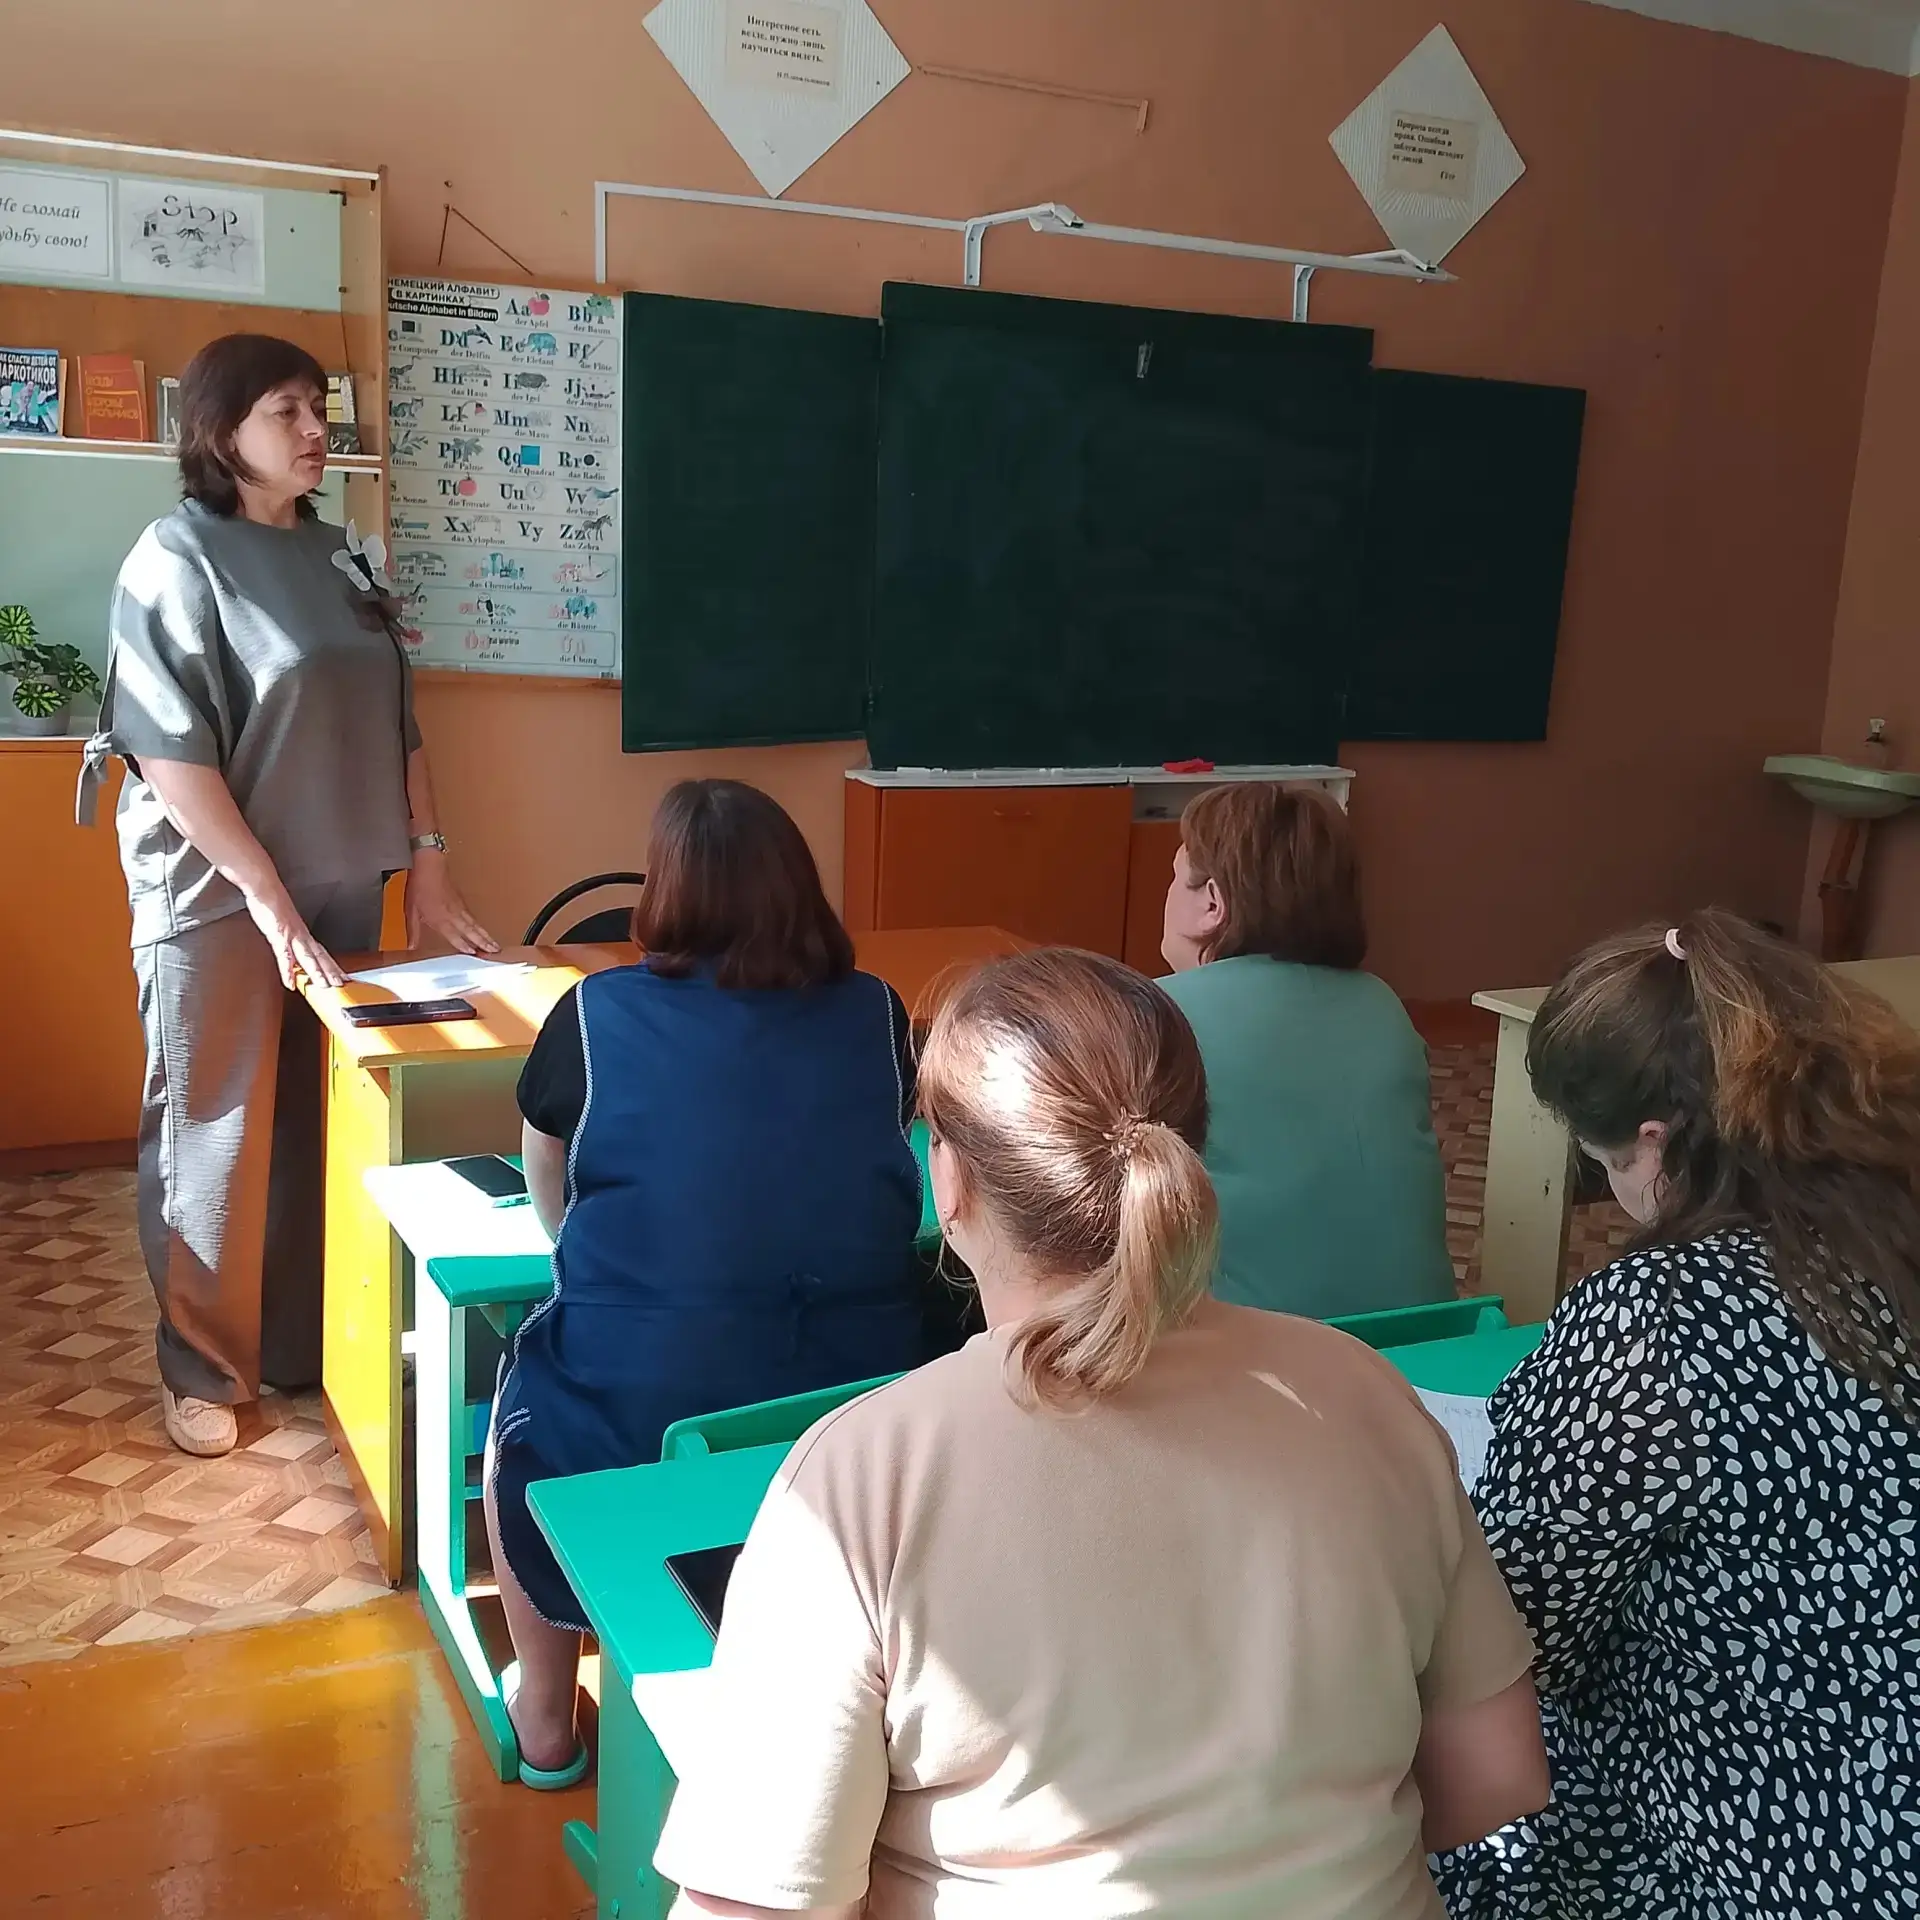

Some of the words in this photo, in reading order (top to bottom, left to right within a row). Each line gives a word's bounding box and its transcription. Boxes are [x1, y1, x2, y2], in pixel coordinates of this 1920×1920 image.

[747, 15, 799, 32] Интересное
[802, 28, 821, 36] есть
[770, 35, 798, 46] нужно
[741, 42, 788, 56] научиться
[22, 204, 81, 219] сломай
[161, 195, 238, 235] Stop
[44, 235, 88, 248] свою!
[388, 278, 445, 292] НЕМЕЦКИЙ
[447, 284, 496, 297] АЛФАВИТ
[396, 290, 402, 298] В
[405, 291, 465, 304] КАРТИНКАХ
[388, 302, 418, 312] utsche
[420, 304, 457, 317] Alphabet
[458, 308, 466, 316] in
[467, 308, 498, 320] Bildern
[505, 298, 531, 316] Aa
[529, 319, 549, 328] Apfel
[399, 344, 439, 355] Computer
[450, 349, 463, 357] der
[466, 350, 491, 360] Delfin
[8, 354, 31, 364] СПАСТИ
[48, 356, 57, 367] ОТ
[526, 356, 554, 366] Elefant
[432, 366, 464, 385] Hh
[451, 388, 465, 396] das
[467, 389, 488, 397] Haus
[564, 378, 581, 399] Jj
[493, 409, 529, 427] Mm
[564, 415, 590, 433] Nn
[463, 425, 490, 436] Lampe
[588, 435, 609, 444] Nadel
[558, 451, 582, 468] Rr
[460, 463, 483, 471] Palme
[523, 468, 555, 477] Quadrat
[500, 483, 524, 500] Uu
[564, 488, 587, 505] Vv
[462, 500, 490, 508] Tomate
[520, 503, 535, 511] Uhr
[580, 508, 598, 517] Vogel
[444, 516, 471, 533] Xx
[404, 532, 431, 540] Wanne
[518, 521, 544, 542] Yy
[560, 524, 586, 540] Zz
[467, 536, 505, 547] Xylophon
[578, 542, 600, 551] Zebra
